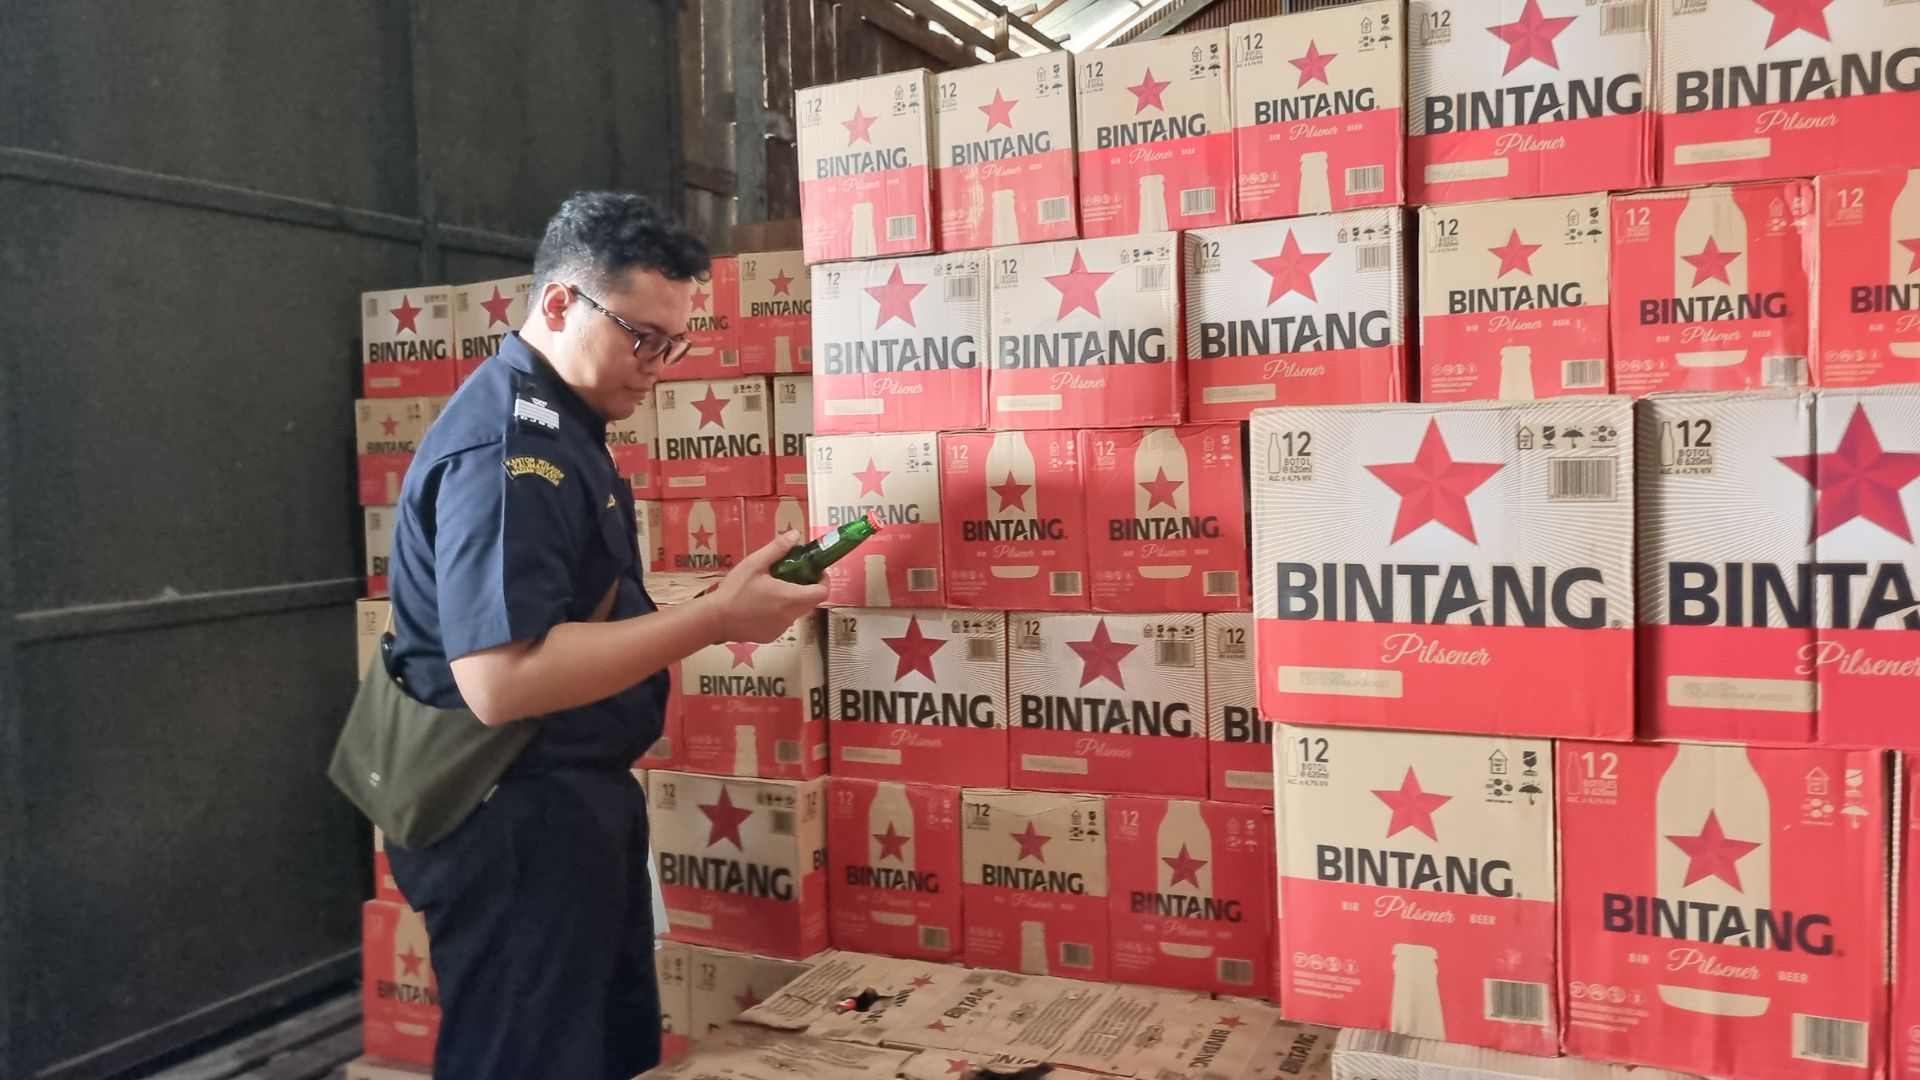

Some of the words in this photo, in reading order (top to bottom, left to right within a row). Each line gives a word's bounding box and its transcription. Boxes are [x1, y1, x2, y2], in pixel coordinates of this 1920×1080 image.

[1430, 10, 1450, 28] 12
[1243, 33, 1263, 50] 12
[1086, 62, 1104, 78] 12
[1676, 47, 1920, 114] BINTANG
[940, 82, 957, 99] 12
[806, 98, 822, 113] 12
[1254, 87, 1375, 126] BINTANG
[1425, 73, 1643, 135] BINTANG
[1097, 113, 1206, 149] BINTANG
[1289, 124, 1338, 141] Pilsener
[1755, 109, 1838, 134] Pilsener
[951, 131, 1051, 167] BINTANG
[1129, 147, 1174, 164] Pilsener
[1494, 132, 1566, 156] Pilsener
[816, 147, 907, 179] BINTANG
[1838, 188, 1864, 208] 12
[1437, 218, 1459, 237] 12
[1626, 207, 1650, 226] 12
[1202, 241, 1220, 258] 12
[826, 272, 841, 286] 12
[1001, 259, 1018, 275] 12
[751, 300, 812, 317] BINTANG
[1449, 282, 1582, 315] BINTANG
[1640, 292, 1787, 325] BINTANG
[1201, 310, 1391, 359] BINTANG
[1488, 315, 1542, 333] Pilsener
[1680, 326, 1741, 344] Pilsener
[369, 339, 446, 363] BINTANG
[462, 333, 507, 359] BINT
[823, 335, 976, 375] BINTANG
[999, 327, 1166, 370] BINTANG
[1050, 371, 1106, 391] Pilsener
[1263, 359, 1326, 380] Pilsener
[665, 390, 675, 400] 12
[785, 384, 796, 394] 12
[872, 377, 924, 396] Pilsener
[783, 433, 813, 457] BI
[1283, 431, 1311, 457] 12
[1677, 419, 1712, 447] 12
[666, 433, 761, 461] BINTANG
[817, 447, 833, 461] 12
[951, 445, 968, 460] 12
[1096, 441, 1115, 456] 12
[1678, 448, 1711, 457] BOTOL
[962, 518, 1063, 542] BINTANG
[1109, 516, 1220, 541] BINTANG
[674, 554, 733, 569] BINTANG
[1277, 562, 1606, 630] BINTANG
[843, 618, 857, 632] 12
[1025, 620, 1041, 636] 12
[1227, 628, 1244, 644] 12
[1381, 632, 1490, 666] Pilsener
[700, 675, 785, 697] BINTANG
[840, 689, 994, 729] BINTANG
[1021, 694, 1191, 738] BINTANG
[1299, 737, 1328, 763] 12
[1581, 751, 1618, 780] 12
[662, 784, 676, 798] 12
[974, 803, 991, 817] 12
[1121, 810, 1139, 826] 12
[660, 852, 793, 901] BINTANG
[846, 865, 939, 894] BINTANG
[982, 863, 1084, 895] BINTANG
[1317, 844, 1513, 898] BINTANG
[1130, 891, 1242, 923] BINTANG
[1341, 901, 1360, 911] BIR
[1373, 895, 1455, 924] Pilsener
[1469, 914, 1496, 925] BEER
[1603, 892, 1834, 957] BINTANG
[702, 963, 717, 978] 12
[1628, 953, 1649, 965] BIR
[1666, 947, 1761, 981] Pilsener
[1777, 971, 1808, 984] BEER
[944, 988, 994, 1019] BINTANG
[1189, 1029, 1230, 1068] BINTANG
